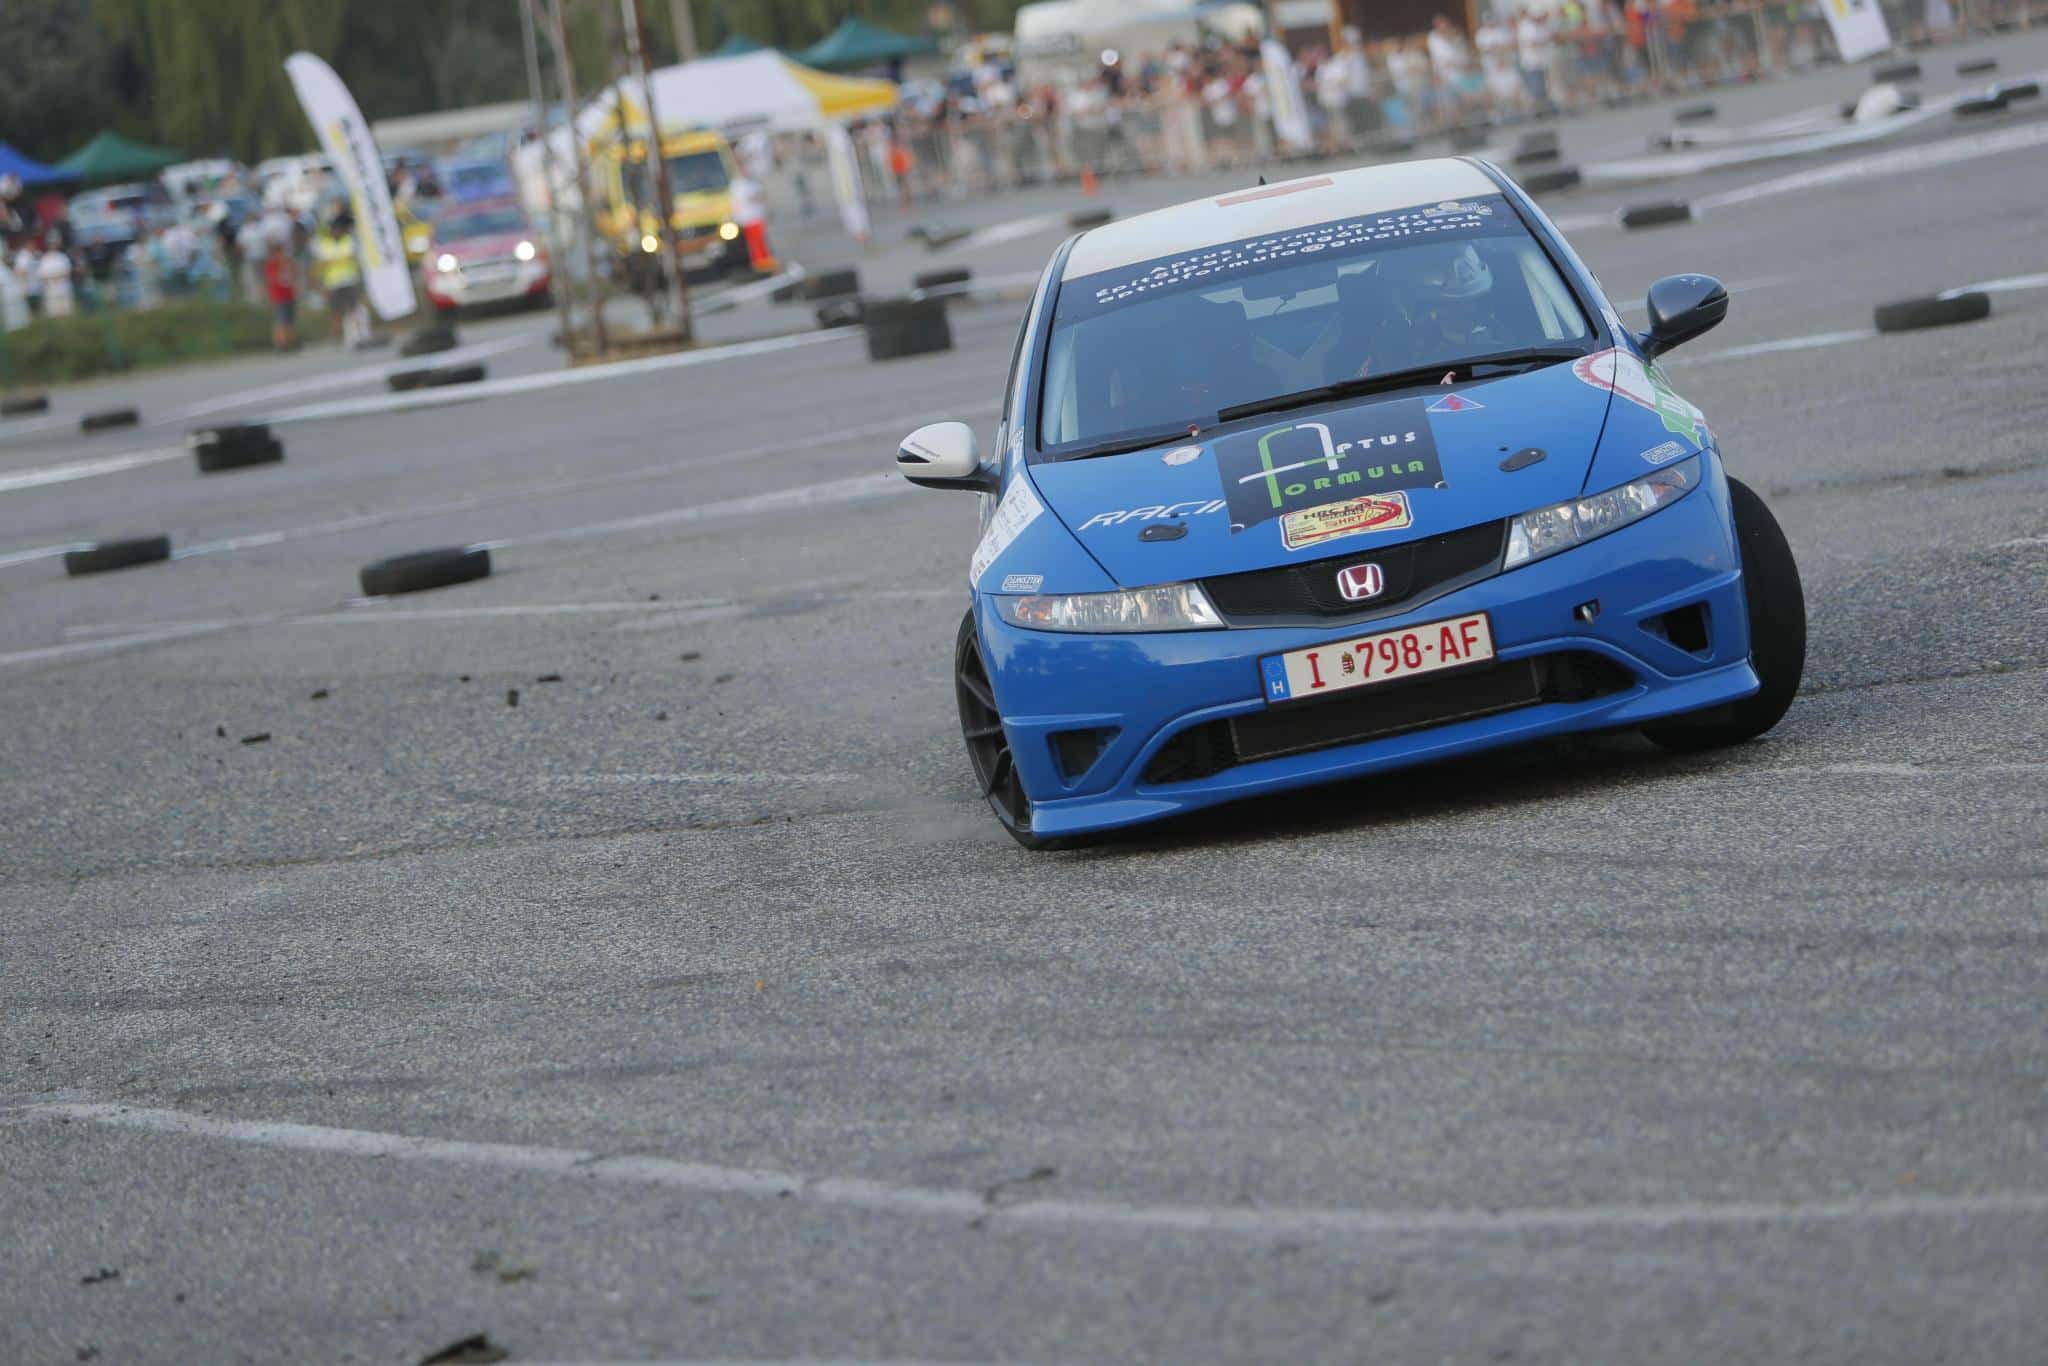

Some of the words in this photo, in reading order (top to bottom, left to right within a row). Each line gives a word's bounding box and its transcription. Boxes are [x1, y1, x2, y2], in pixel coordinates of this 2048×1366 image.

[1150, 248, 1232, 273] Aptus
[1245, 222, 1363, 250] Formula
[1271, 680, 1284, 695] H
[1305, 652, 1326, 689] I
[1355, 619, 1480, 678] 798-AF
